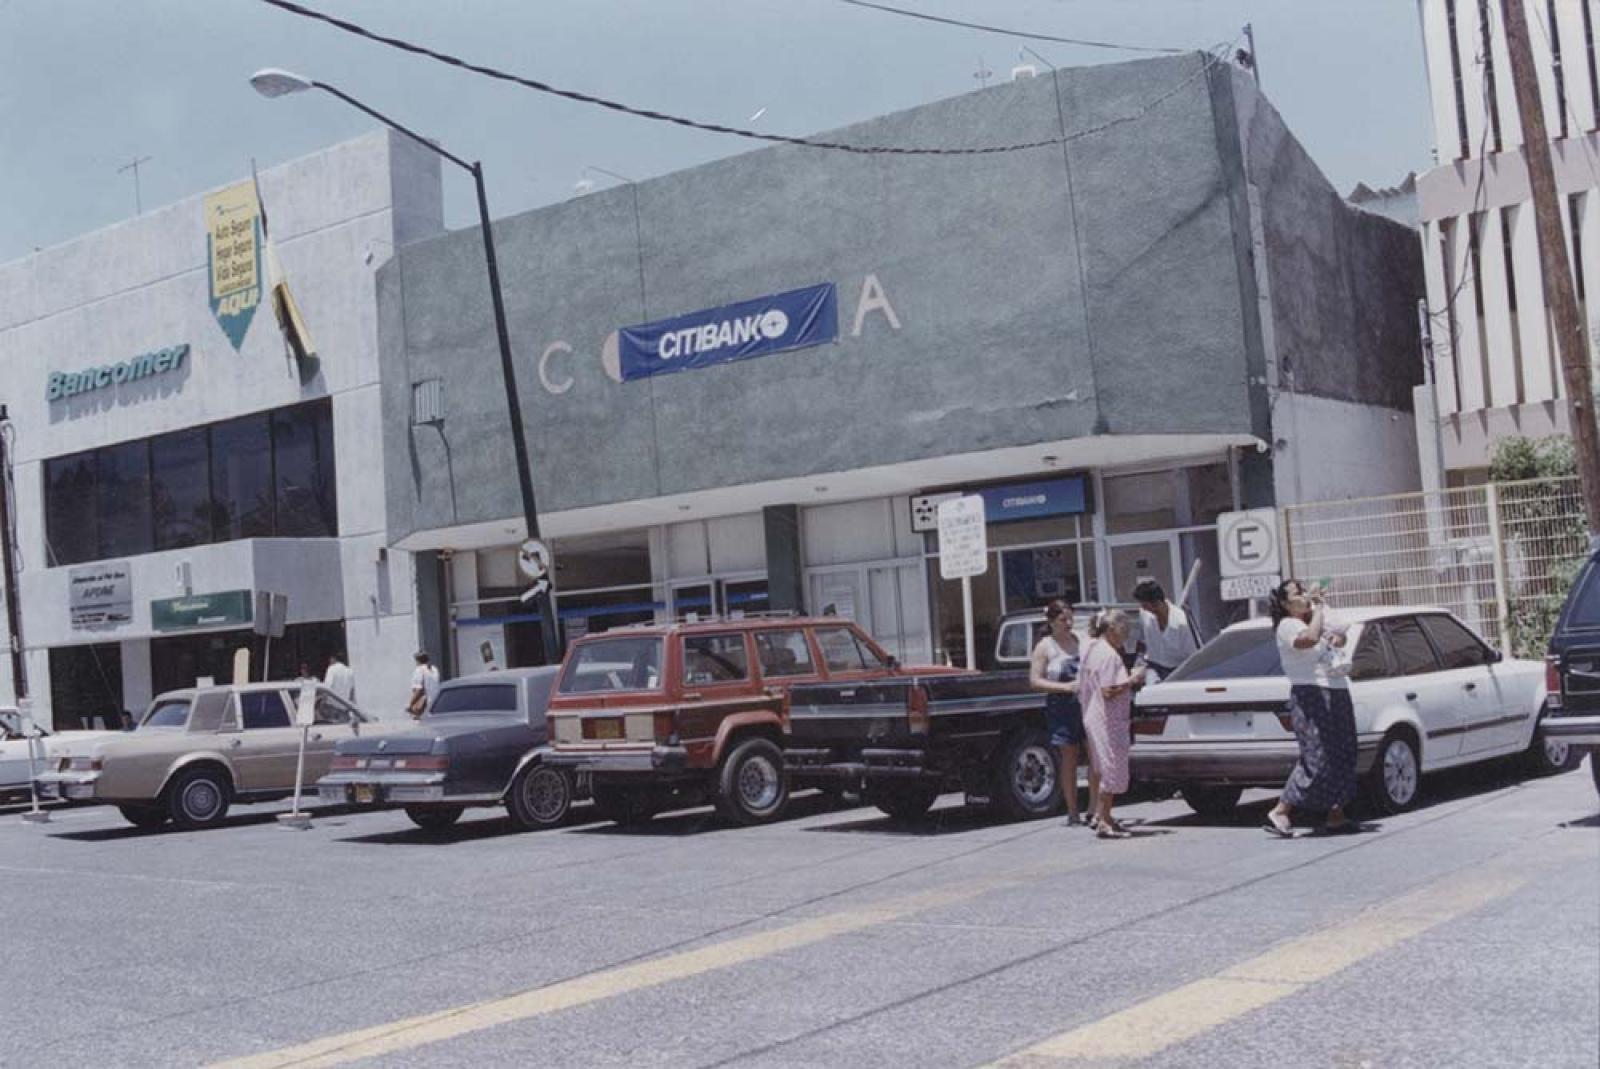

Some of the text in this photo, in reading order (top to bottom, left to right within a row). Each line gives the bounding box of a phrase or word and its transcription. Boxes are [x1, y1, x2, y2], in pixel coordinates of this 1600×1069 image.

[851, 273, 901, 336] A
[659, 313, 763, 359] CITIBANK
[48, 342, 191, 400] Bancomer
[1236, 525, 1260, 560] E
